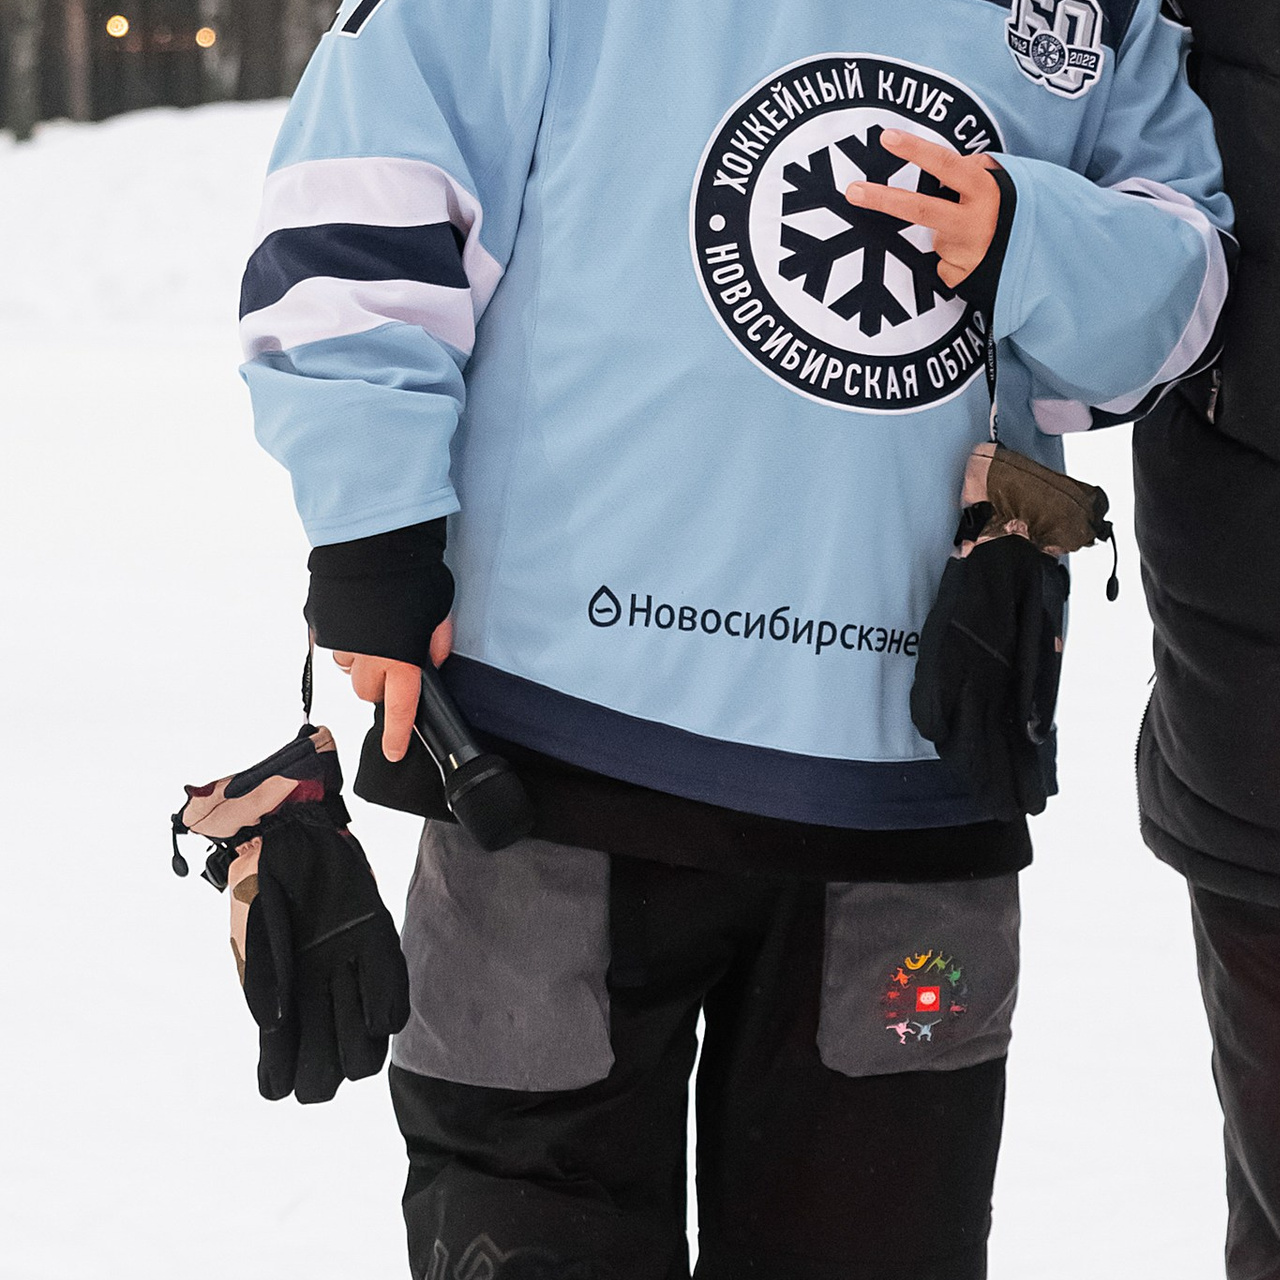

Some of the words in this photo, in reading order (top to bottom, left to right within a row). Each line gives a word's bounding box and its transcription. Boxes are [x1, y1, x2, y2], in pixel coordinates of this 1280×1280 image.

[1069, 51, 1097, 69] 2022
[712, 61, 865, 196] ХОККЕЙНЫЙ
[878, 69, 954, 122] КЛУБ
[704, 242, 919, 400] НОВОСИБИРСКАЯ
[628, 593, 920, 656] Новосибирскэне
